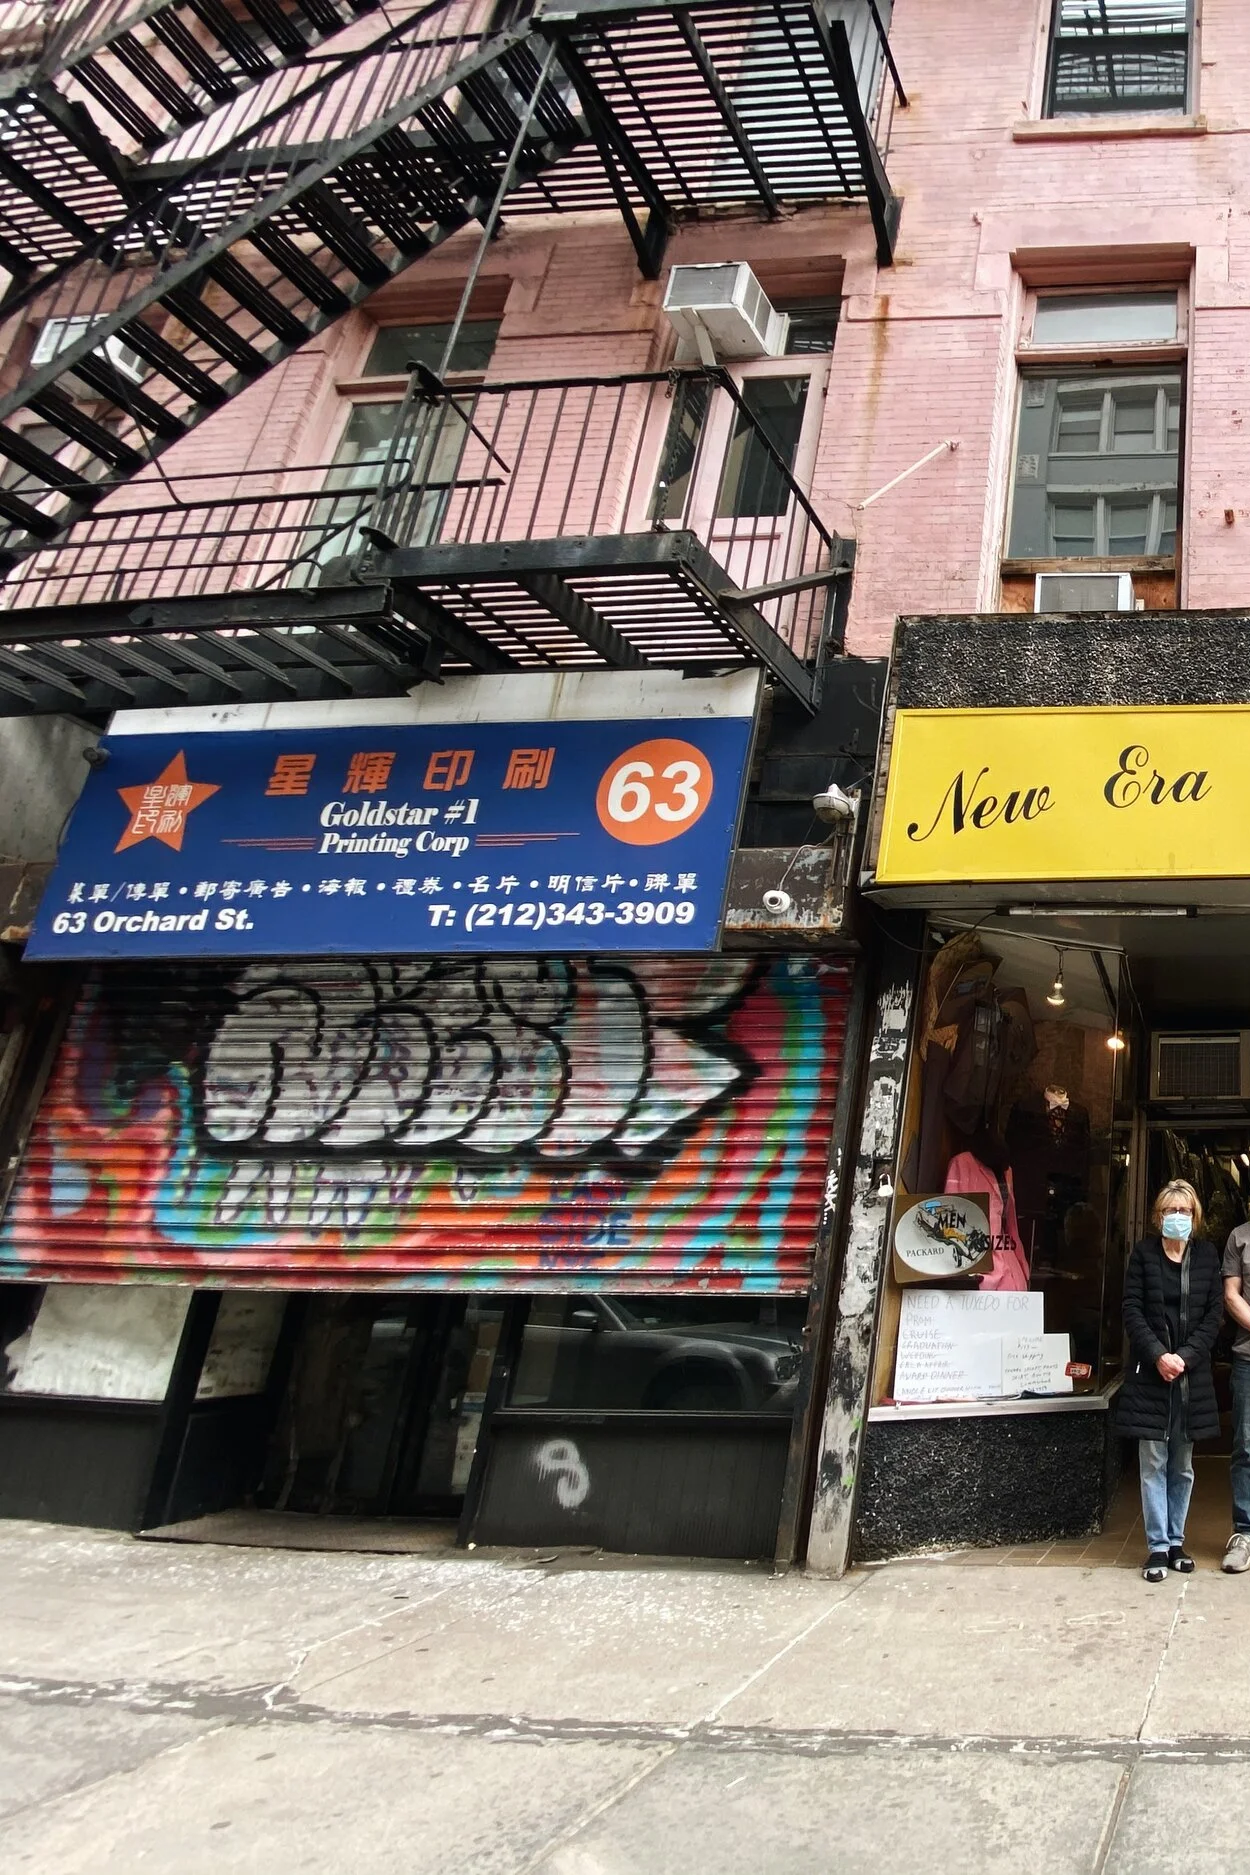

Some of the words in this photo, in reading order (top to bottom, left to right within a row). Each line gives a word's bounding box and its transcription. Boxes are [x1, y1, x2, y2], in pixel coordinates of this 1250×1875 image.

[264, 747, 555, 796] 星輝印刷
[607, 760, 701, 823] 63
[907, 766, 1056, 842] New
[1103, 744, 1212, 808] Era
[320, 800, 439, 827] Goldstar
[443, 799, 479, 825] #1
[318, 832, 414, 858] Printing
[415, 831, 469, 857] Corp
[53, 912, 86, 934] 63
[93, 908, 209, 933] Orchard
[215, 908, 254, 932] St.
[428, 904, 456, 927] T:
[464, 901, 695, 932] (212)343-3909
[939, 1212, 967, 1229] MEN
[906, 1247, 945, 1257] PACKARD
[906, 1294, 945, 1310] NEED
[946, 1295, 957, 1309] A
[960, 1294, 999, 1311] TUXEDO
[1007, 1295, 1029, 1311] FOR
[905, 1312, 932, 1325] PROM
